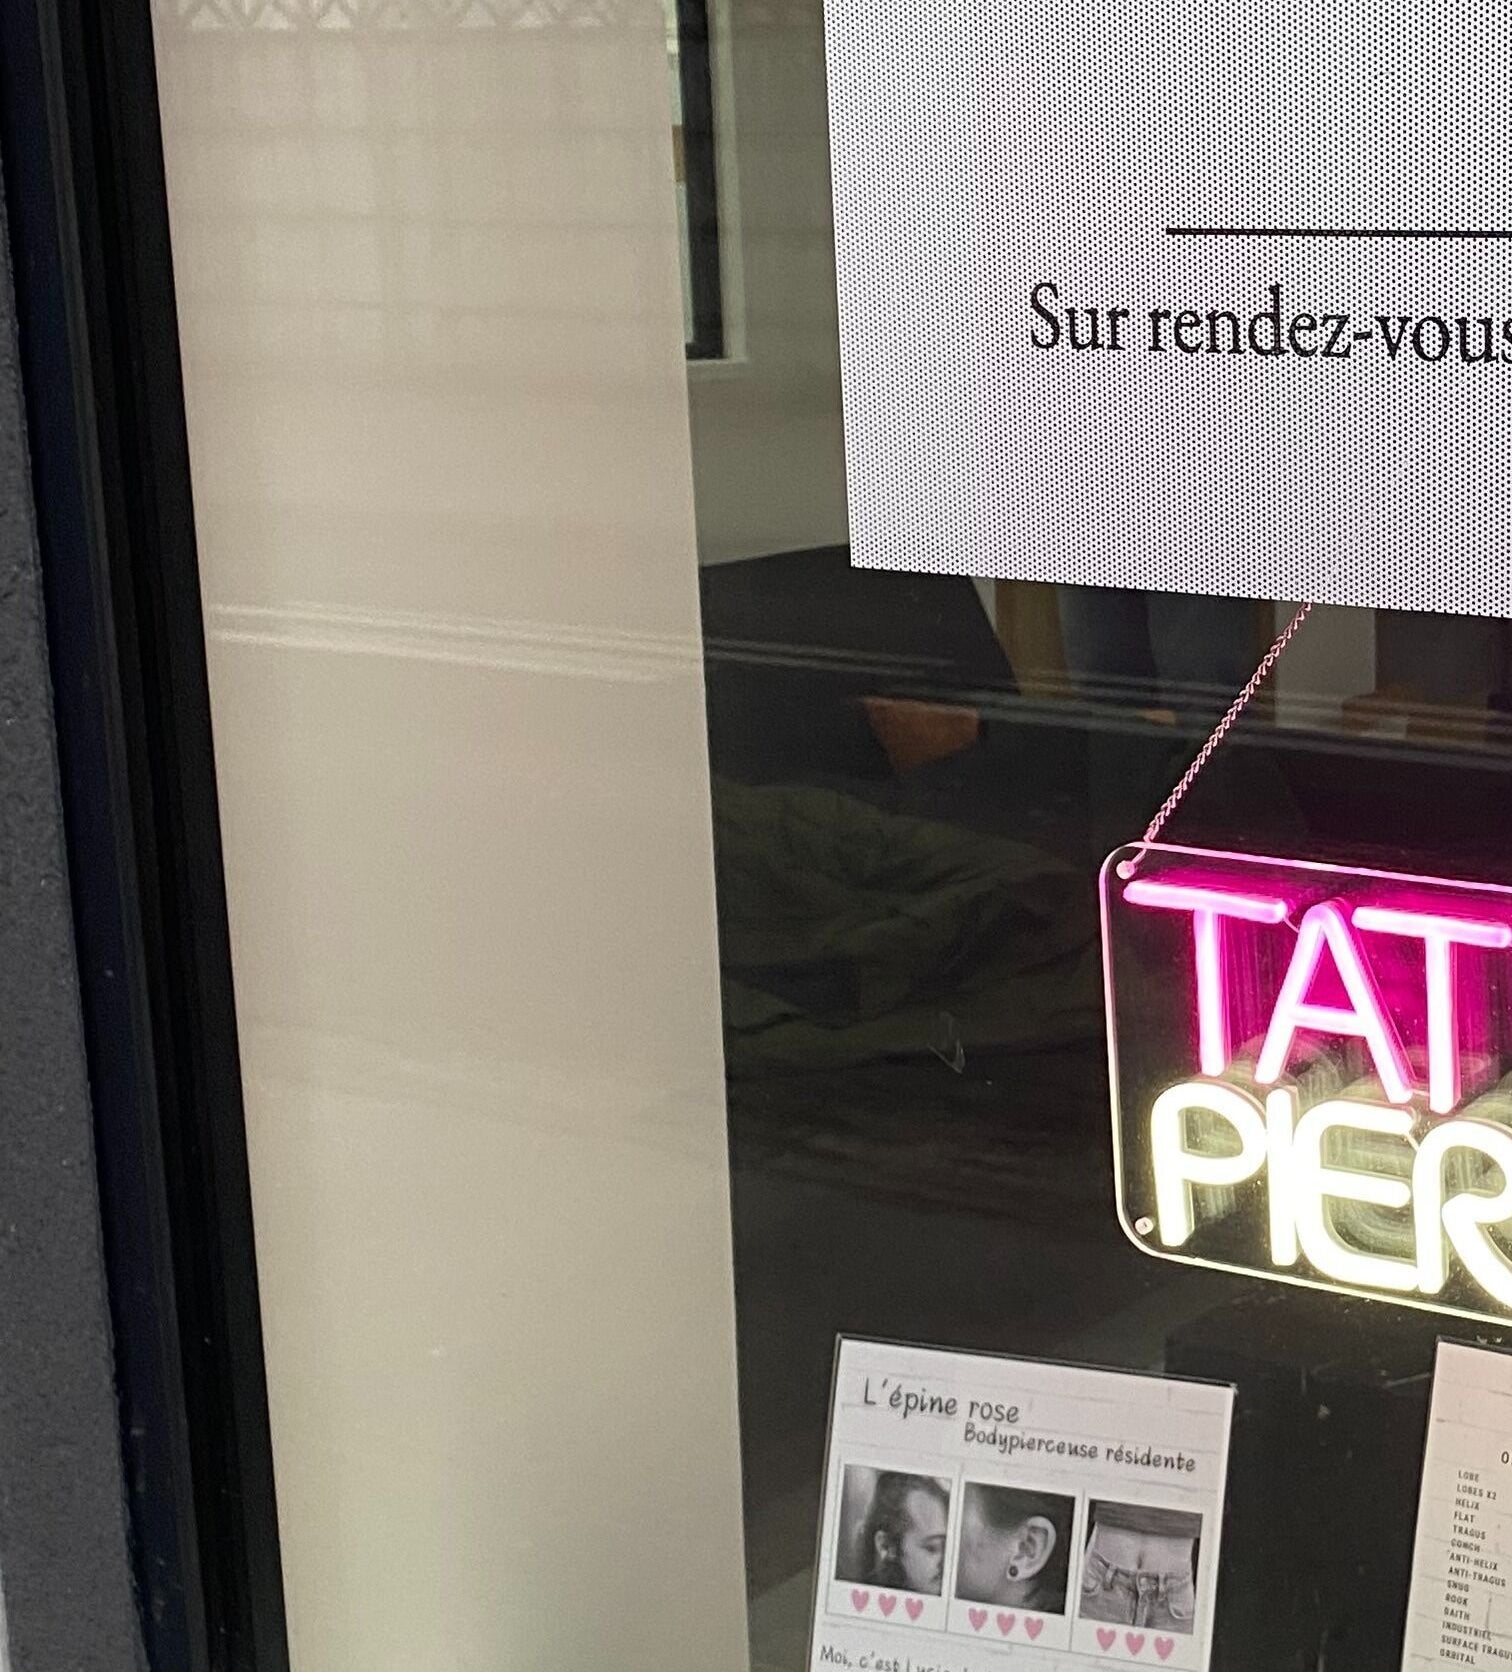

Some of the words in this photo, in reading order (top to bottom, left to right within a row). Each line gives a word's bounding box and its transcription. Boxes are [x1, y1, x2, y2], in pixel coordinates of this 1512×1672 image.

[1030, 281, 1130, 353] Sur
[864, 1377, 957, 1419] L'épine
[969, 1401, 1021, 1424] rose
[964, 1422, 1099, 1457] Bodypierceuse
[1105, 1445, 1197, 1473] résidente
[1458, 1469, 1480, 1483] LOBE
[1456, 1483, 1483, 1498] LOBES
[1455, 1497, 1480, 1511] HELIX
[1453, 1510, 1476, 1524] FLAT
[1452, 1524, 1486, 1541] TRAGUS
[1449, 1552, 1498, 1571] ANTI-HELIX
[1448, 1566, 1507, 1588] ANTI-TRAGUS
[1441, 1635, 1479, 1651] SURFACE
[820, 1644, 853, 1668] Moi,
[1440, 1648, 1476, 1665] ORBITAL
